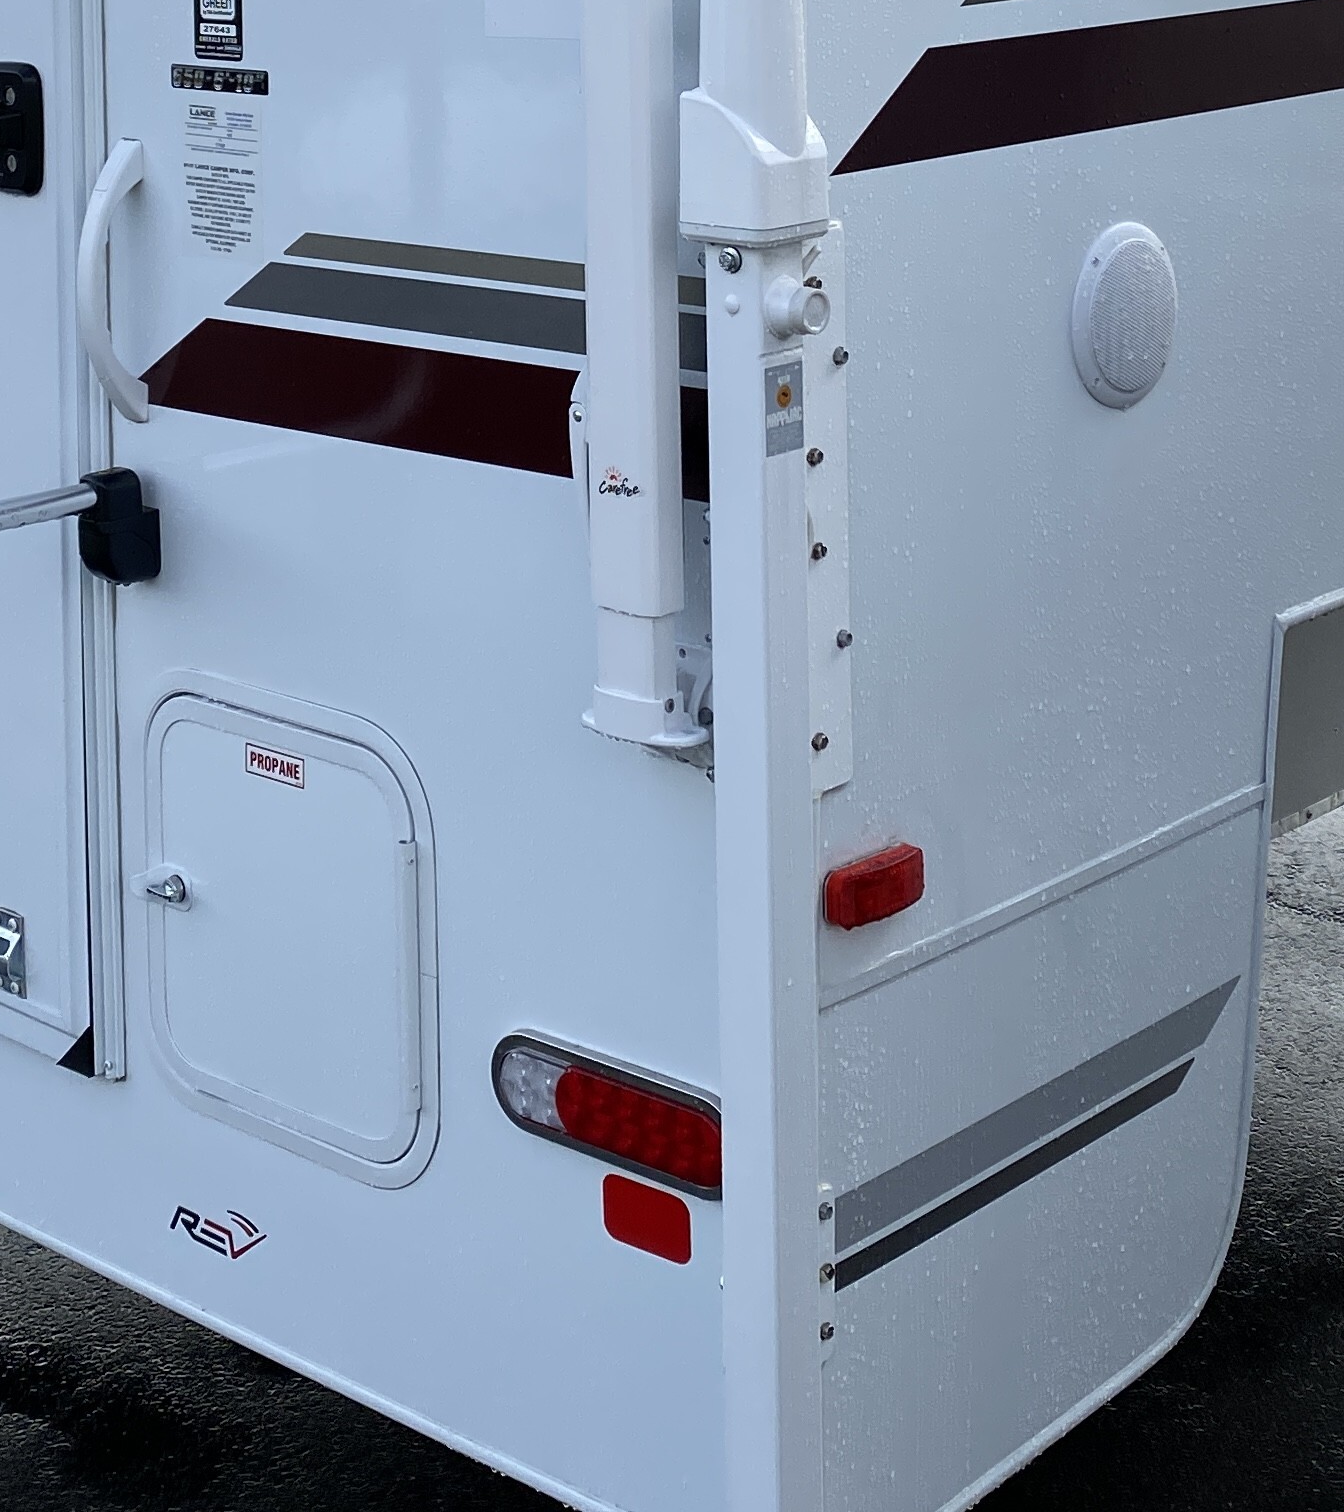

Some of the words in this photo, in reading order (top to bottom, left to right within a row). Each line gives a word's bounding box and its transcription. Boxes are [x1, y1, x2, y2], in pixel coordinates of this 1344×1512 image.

[189, 107, 216, 118] LANCE
[598, 477, 641, 498] Carefree
[249, 750, 301, 781] PROPANE
